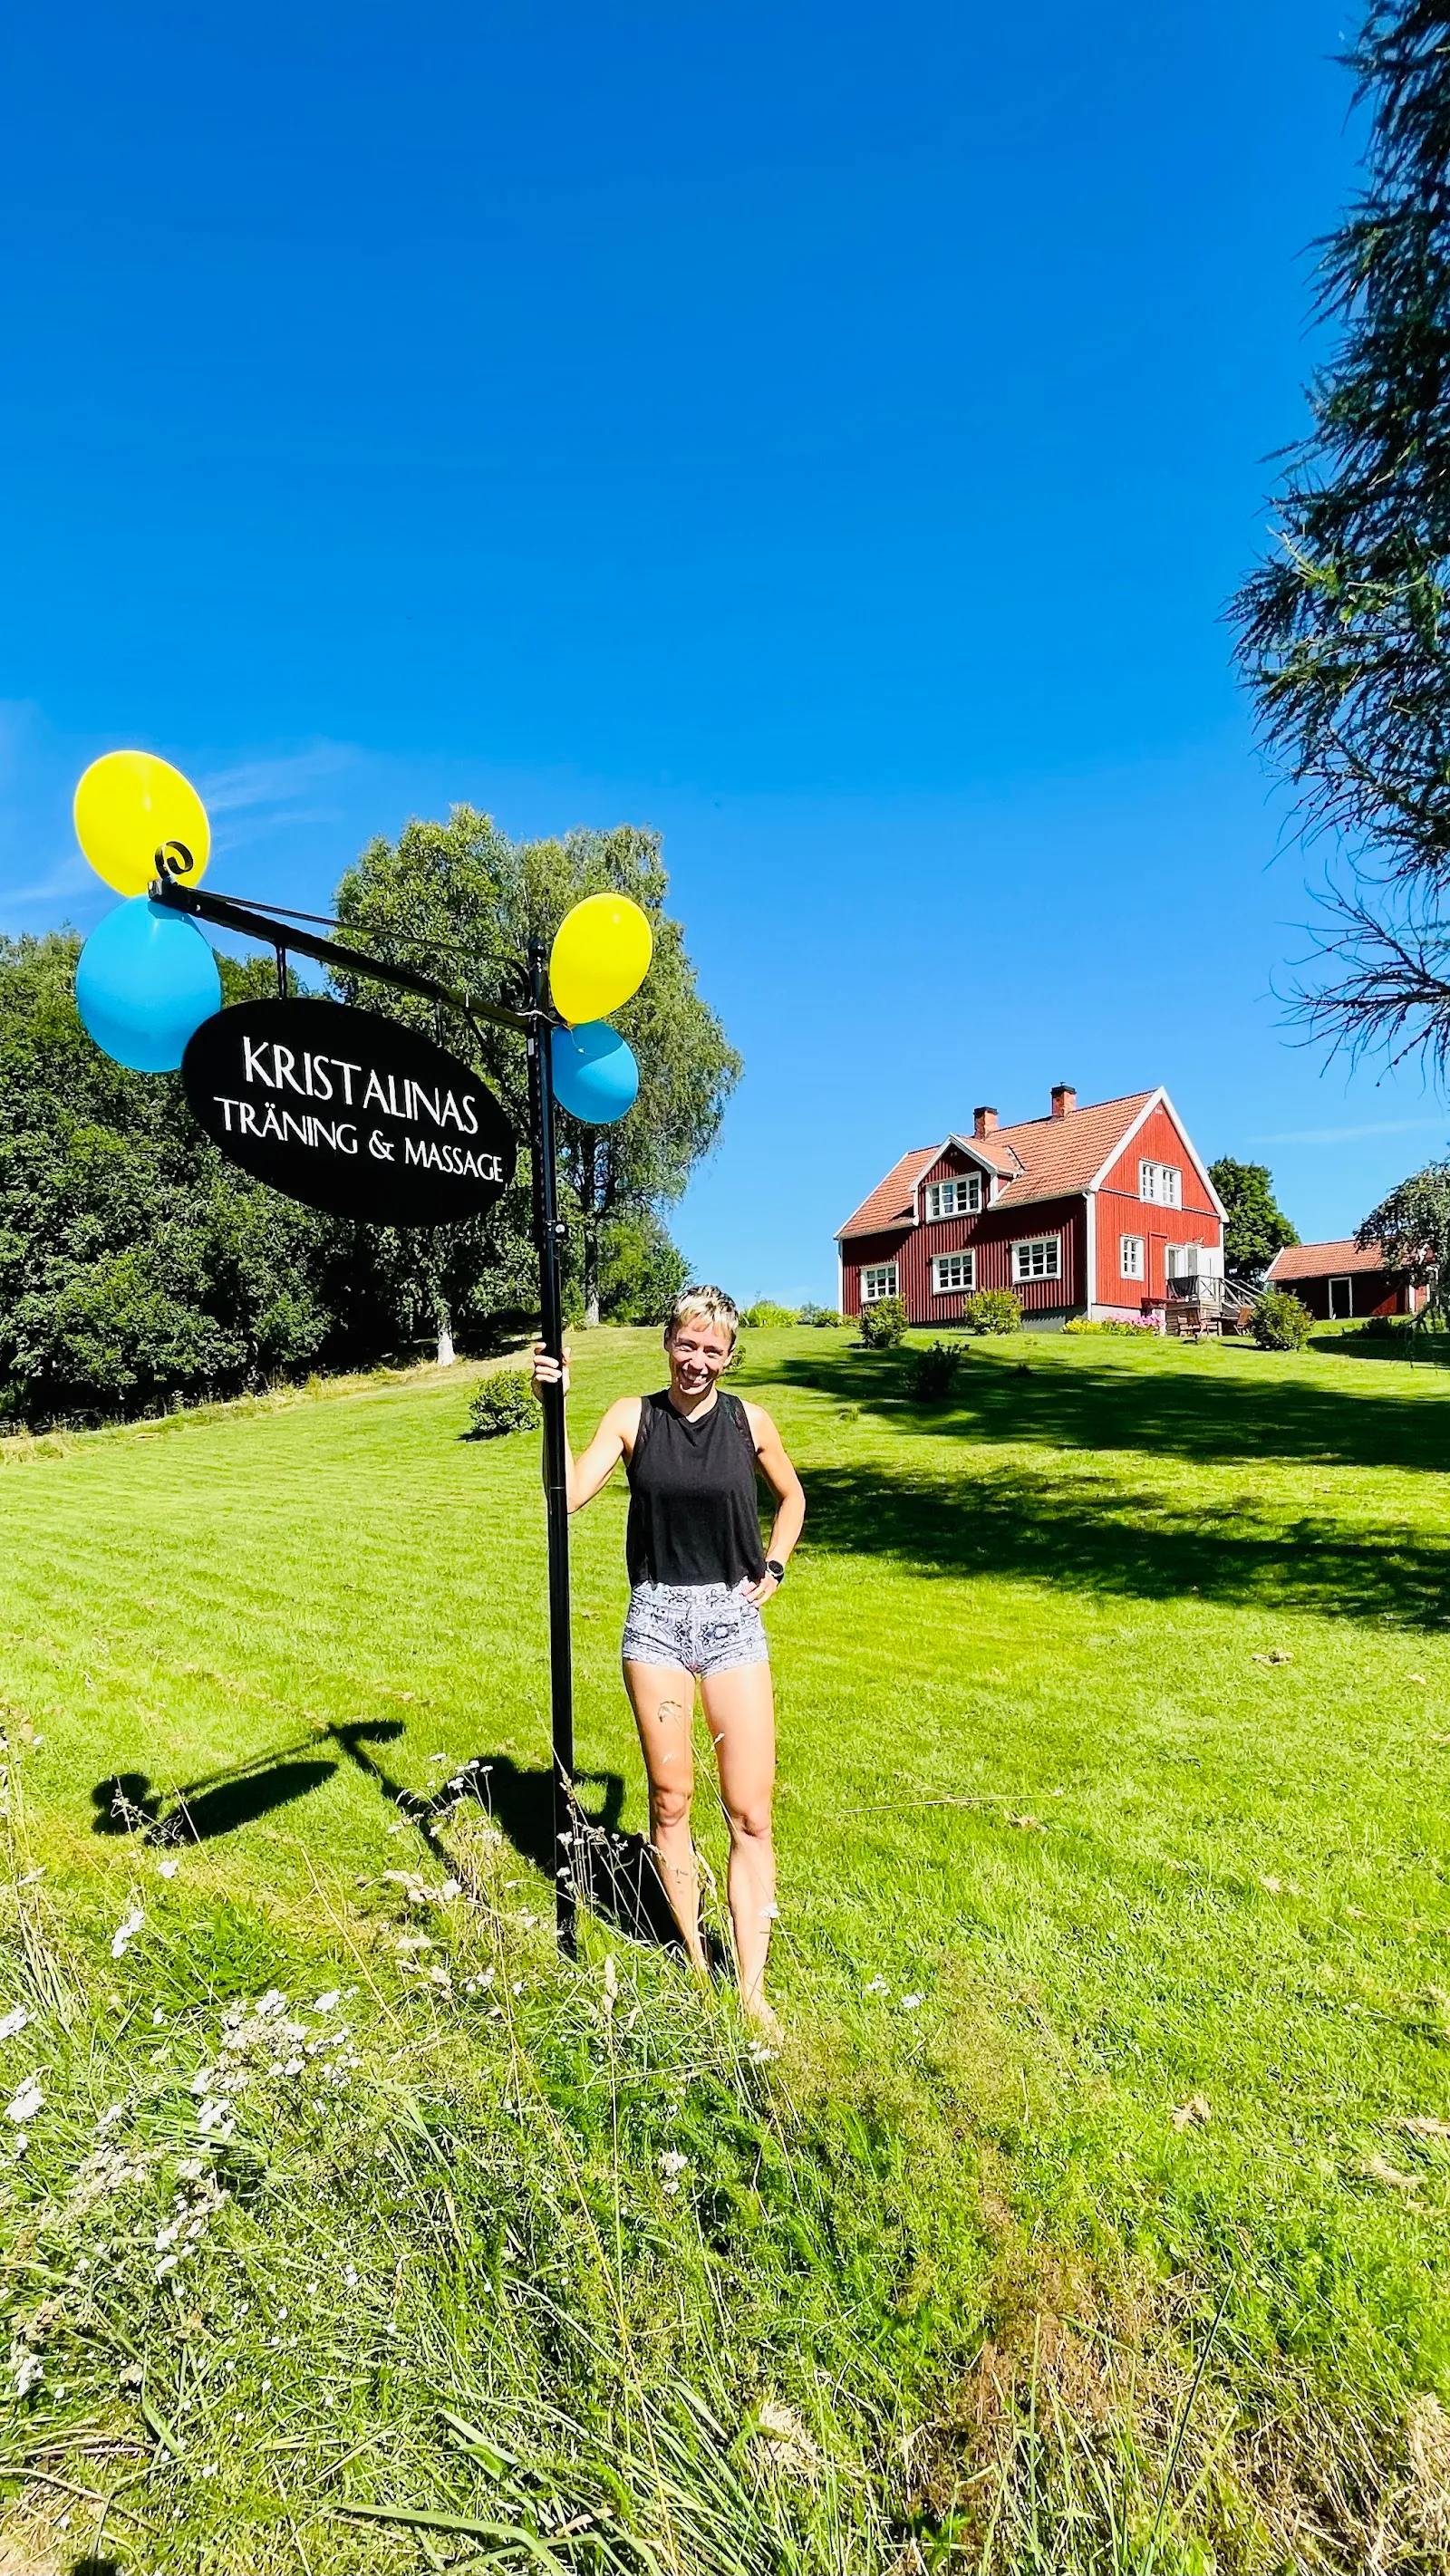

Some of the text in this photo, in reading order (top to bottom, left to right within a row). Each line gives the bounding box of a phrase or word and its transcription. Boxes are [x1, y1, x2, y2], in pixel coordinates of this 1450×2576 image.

[243, 1036, 478, 1134] KRISTALINAS
[213, 1096, 504, 1182] TRÄNING & MASSAGE
